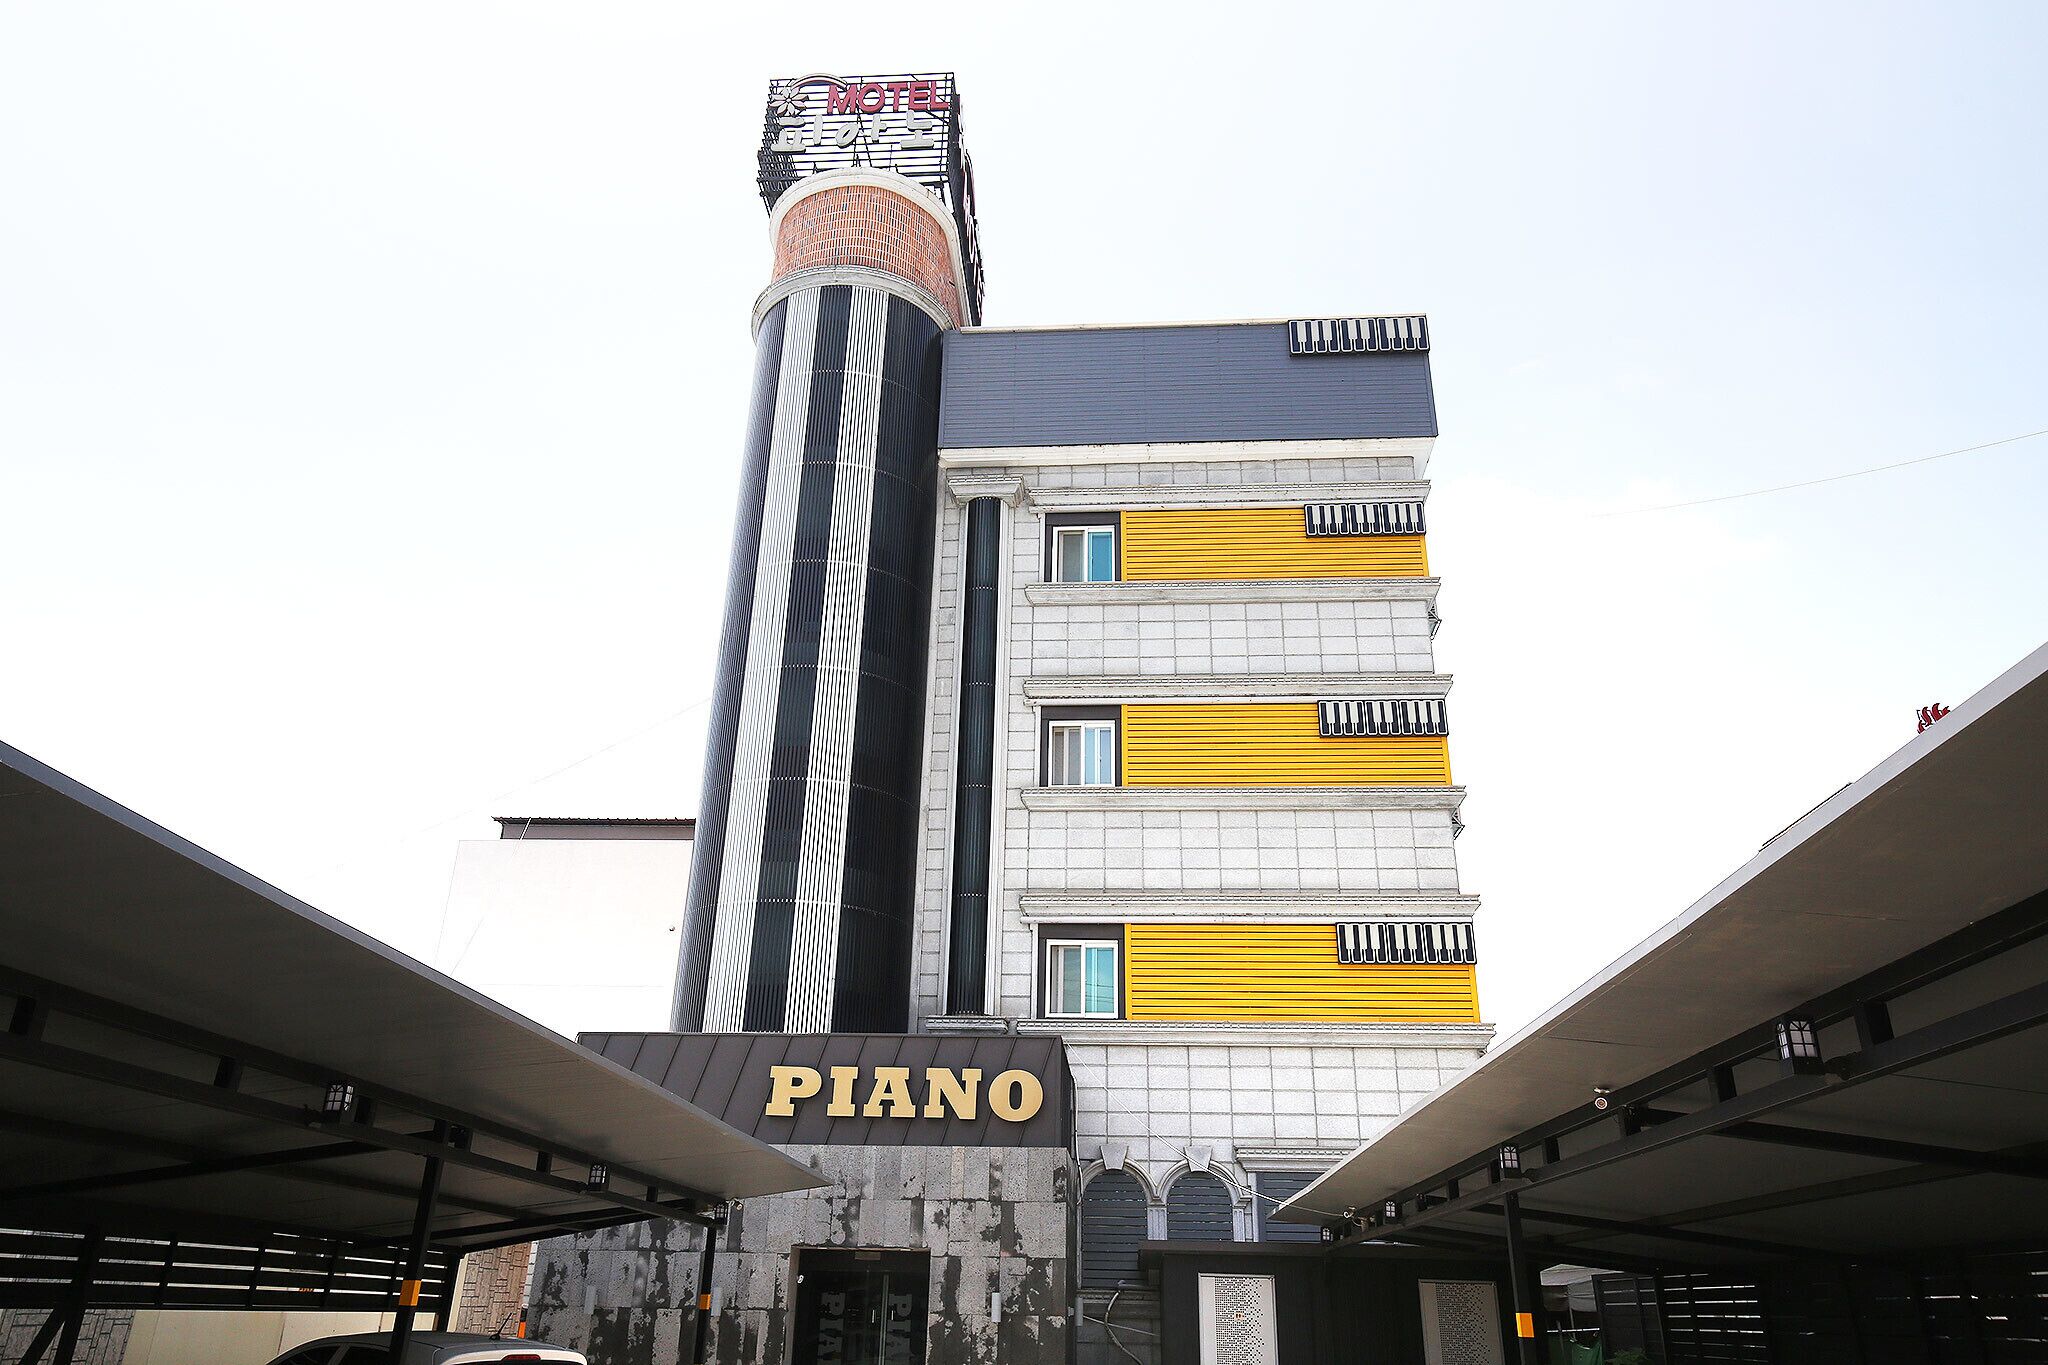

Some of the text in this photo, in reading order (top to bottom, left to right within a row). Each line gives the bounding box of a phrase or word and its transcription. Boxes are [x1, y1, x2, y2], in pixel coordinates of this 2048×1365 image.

[827, 81, 950, 115] MOTEL
[771, 110, 935, 153] 피아노
[765, 1065, 1044, 1122] PIANO
[817, 1292, 846, 1365] PIA
[884, 1294, 913, 1365] PIA
